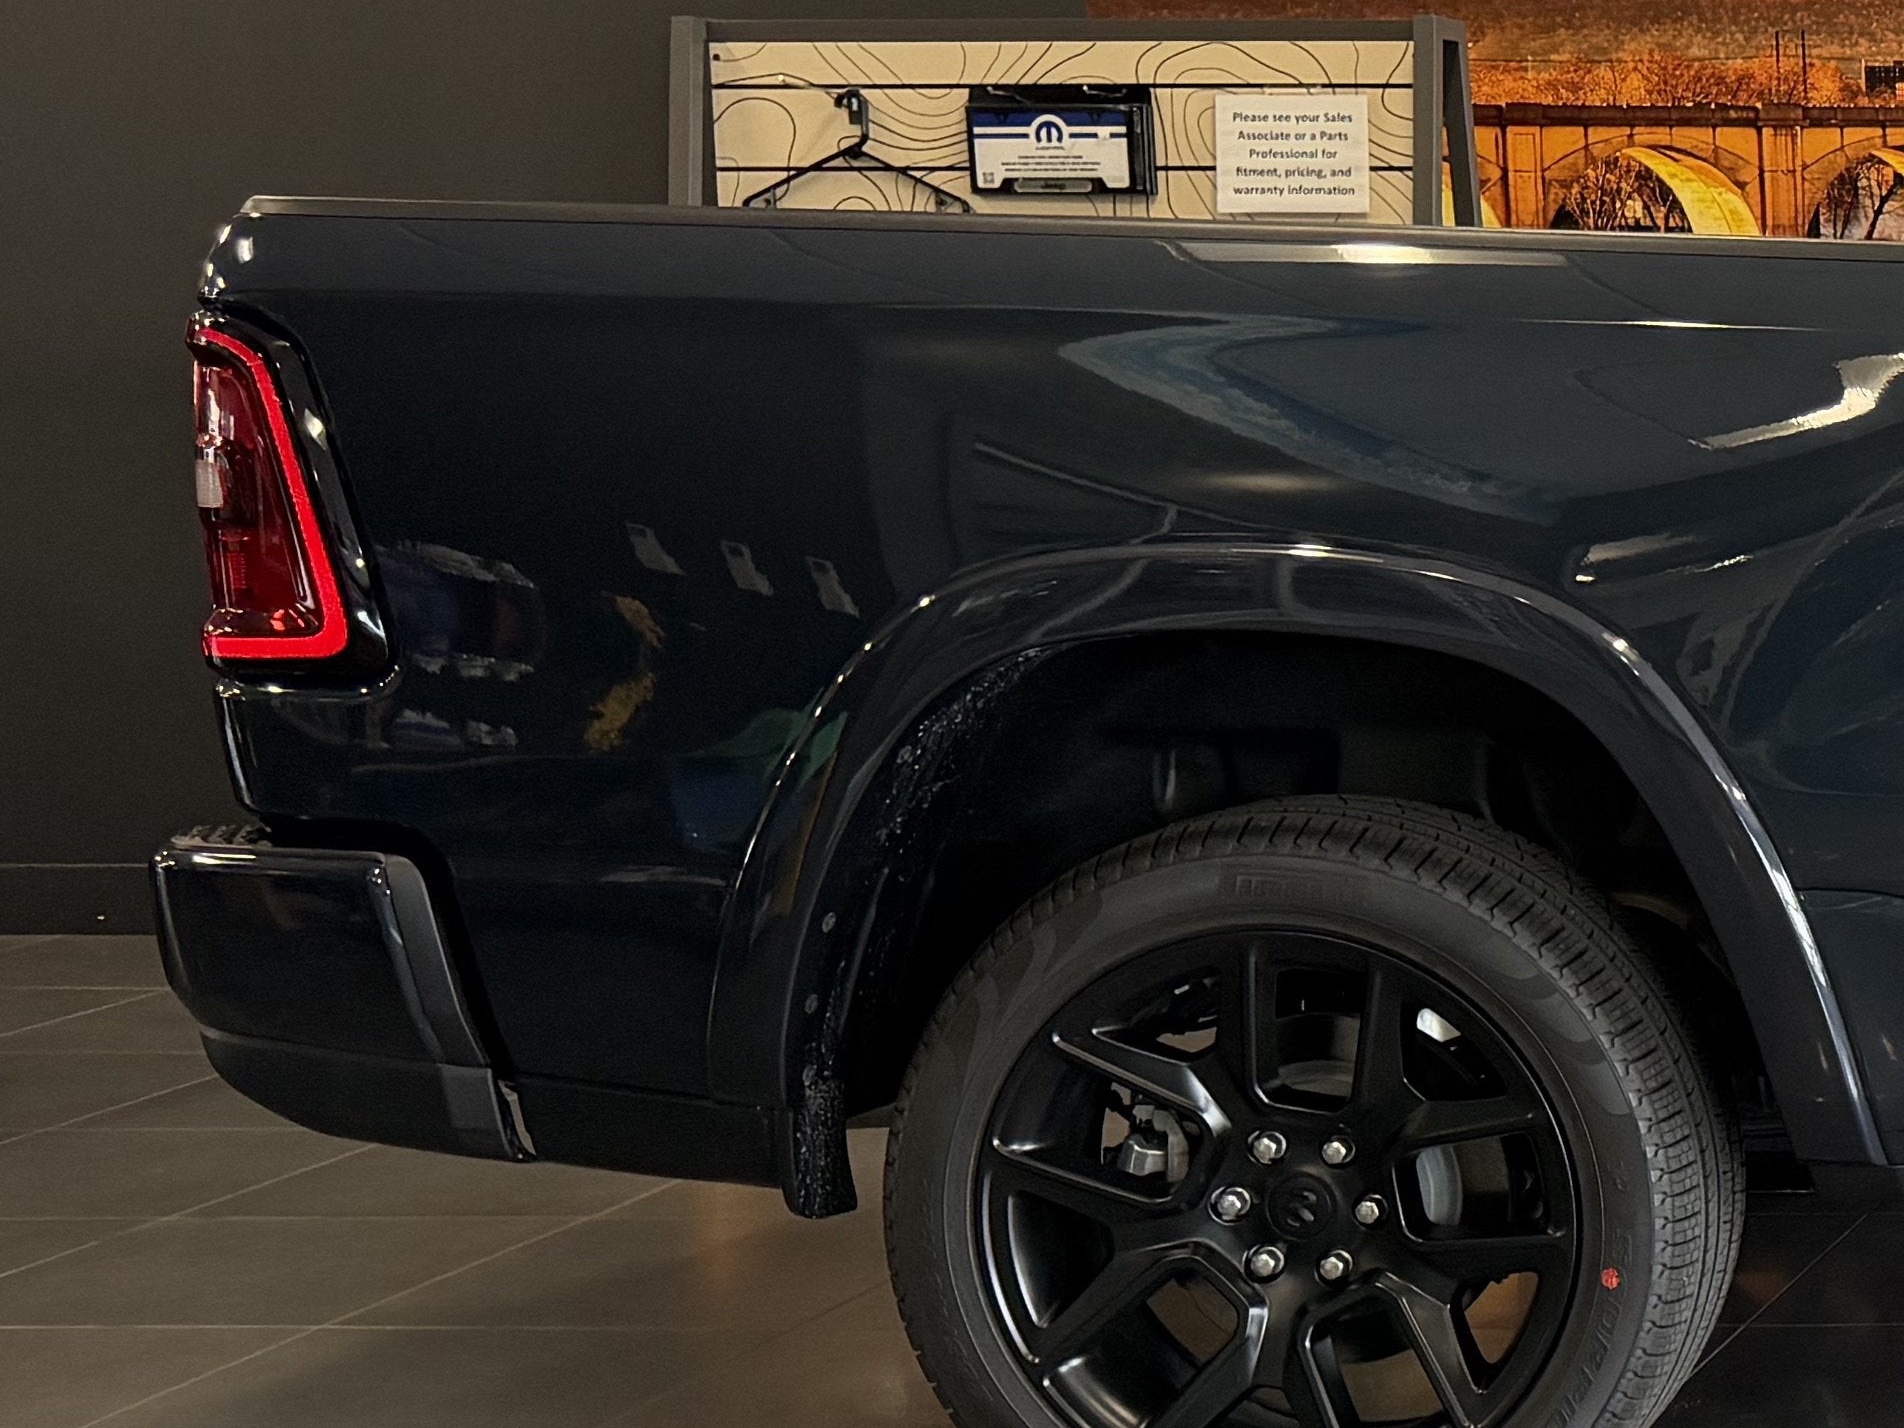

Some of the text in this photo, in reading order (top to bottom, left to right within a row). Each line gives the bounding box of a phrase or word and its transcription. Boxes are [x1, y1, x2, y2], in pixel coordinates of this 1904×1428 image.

[1232, 111, 1353, 125] Please see your Sales
[1237, 129, 1349, 141] Associate or a Parts
[1249, 148, 1338, 159] Professional for
[1236, 166, 1352, 179] fitment, pricing, and
[1233, 185, 1285, 197] warranty
